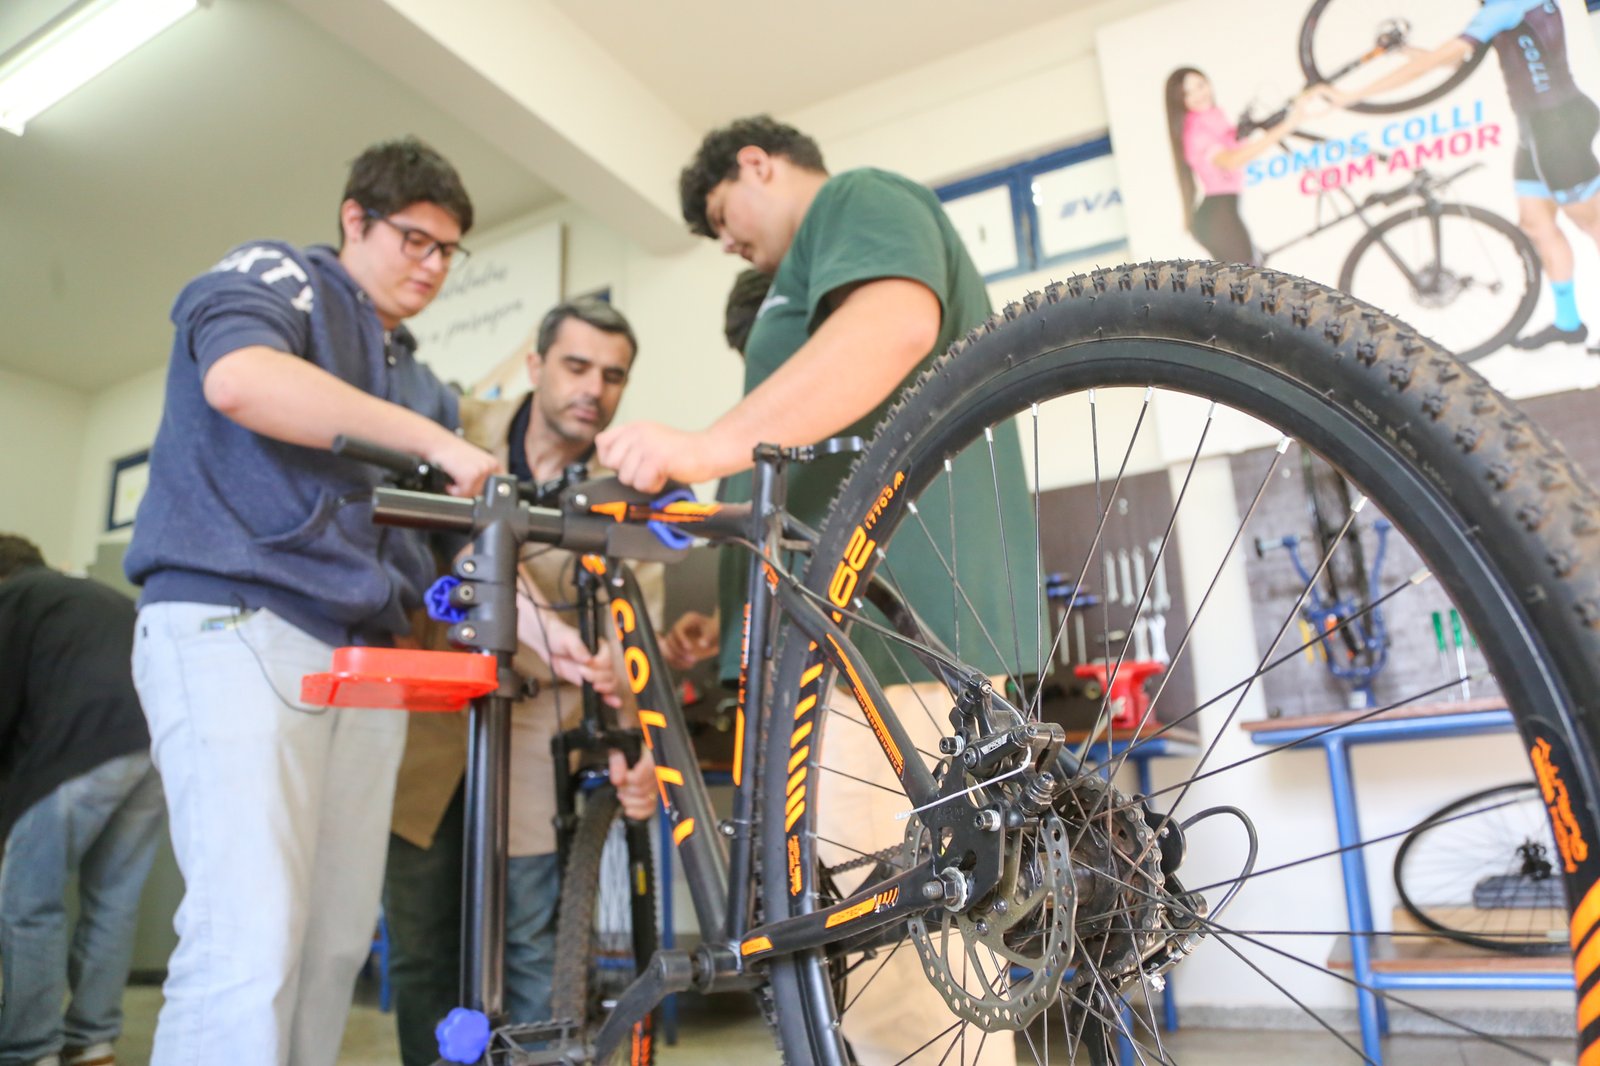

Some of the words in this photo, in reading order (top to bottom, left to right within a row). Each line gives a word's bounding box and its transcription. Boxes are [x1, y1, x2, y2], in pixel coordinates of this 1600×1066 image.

[1518, 34, 1551, 95] COLLI
[1245, 131, 1370, 186] SOMOS
[1382, 100, 1484, 149] COLLI
[1300, 156, 1375, 196] COM
[1388, 123, 1502, 174] AMOR
[610, 598, 695, 846] COLLI
